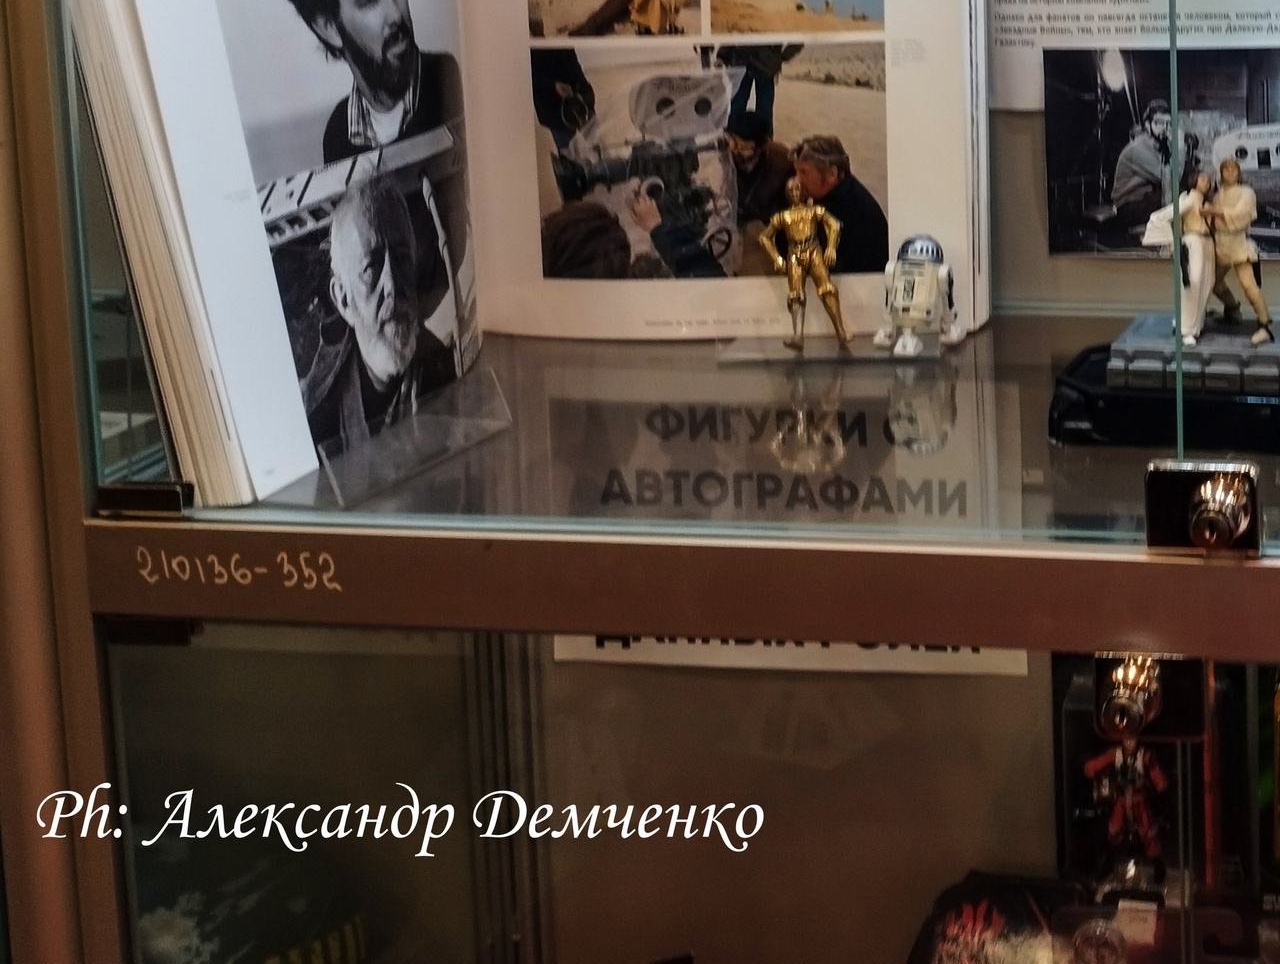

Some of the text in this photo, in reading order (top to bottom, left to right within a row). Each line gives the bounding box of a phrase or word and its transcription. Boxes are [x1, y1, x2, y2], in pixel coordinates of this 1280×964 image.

[645, 403, 868, 448] ФИГУРКИ
[600, 468, 968, 517] АВТОГРАФАМИ
[136, 545, 342, 592] 210136-352
